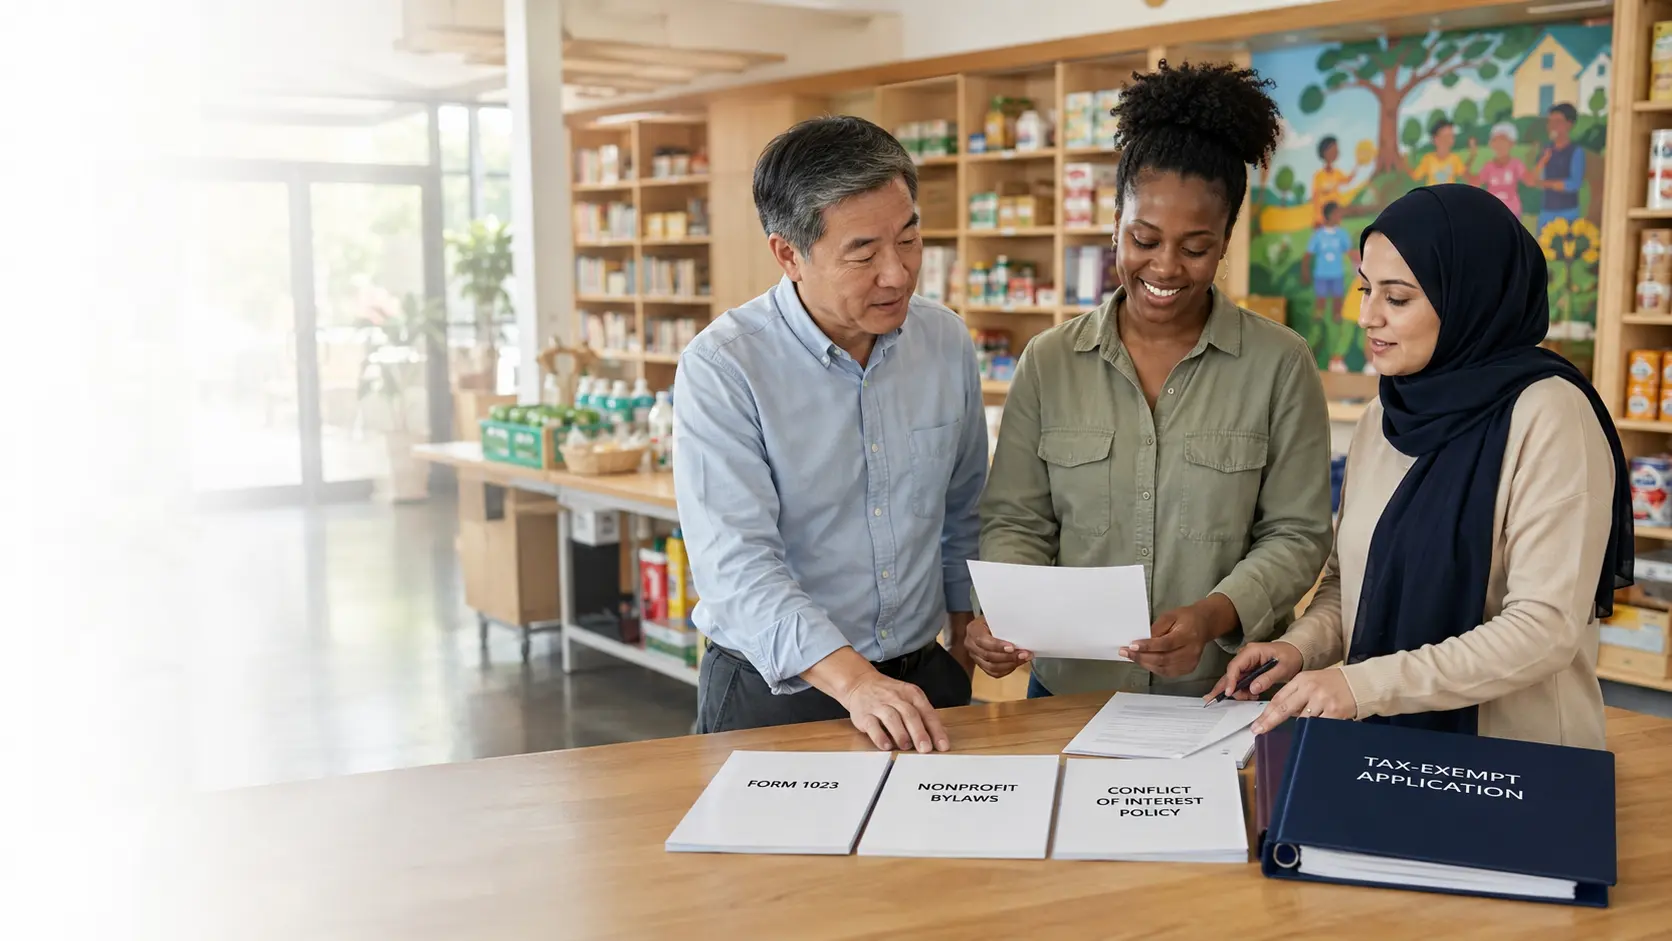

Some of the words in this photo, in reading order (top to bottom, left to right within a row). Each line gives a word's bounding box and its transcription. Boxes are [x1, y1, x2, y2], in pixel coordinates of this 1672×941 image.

[1364, 756, 1521, 785] TAX-EXEMPT
[747, 779, 798, 789] FORM
[802, 780, 840, 790] 1023
[917, 783, 1019, 792] NONPROFIT
[1356, 771, 1523, 800] APPLICATION
[1107, 786, 1192, 795] CONFLICT
[930, 794, 999, 803] BYLAWS
[1096, 797, 1120, 806] OF
[1125, 796, 1204, 806] INTEREST
[1119, 808, 1181, 817] POLICY
